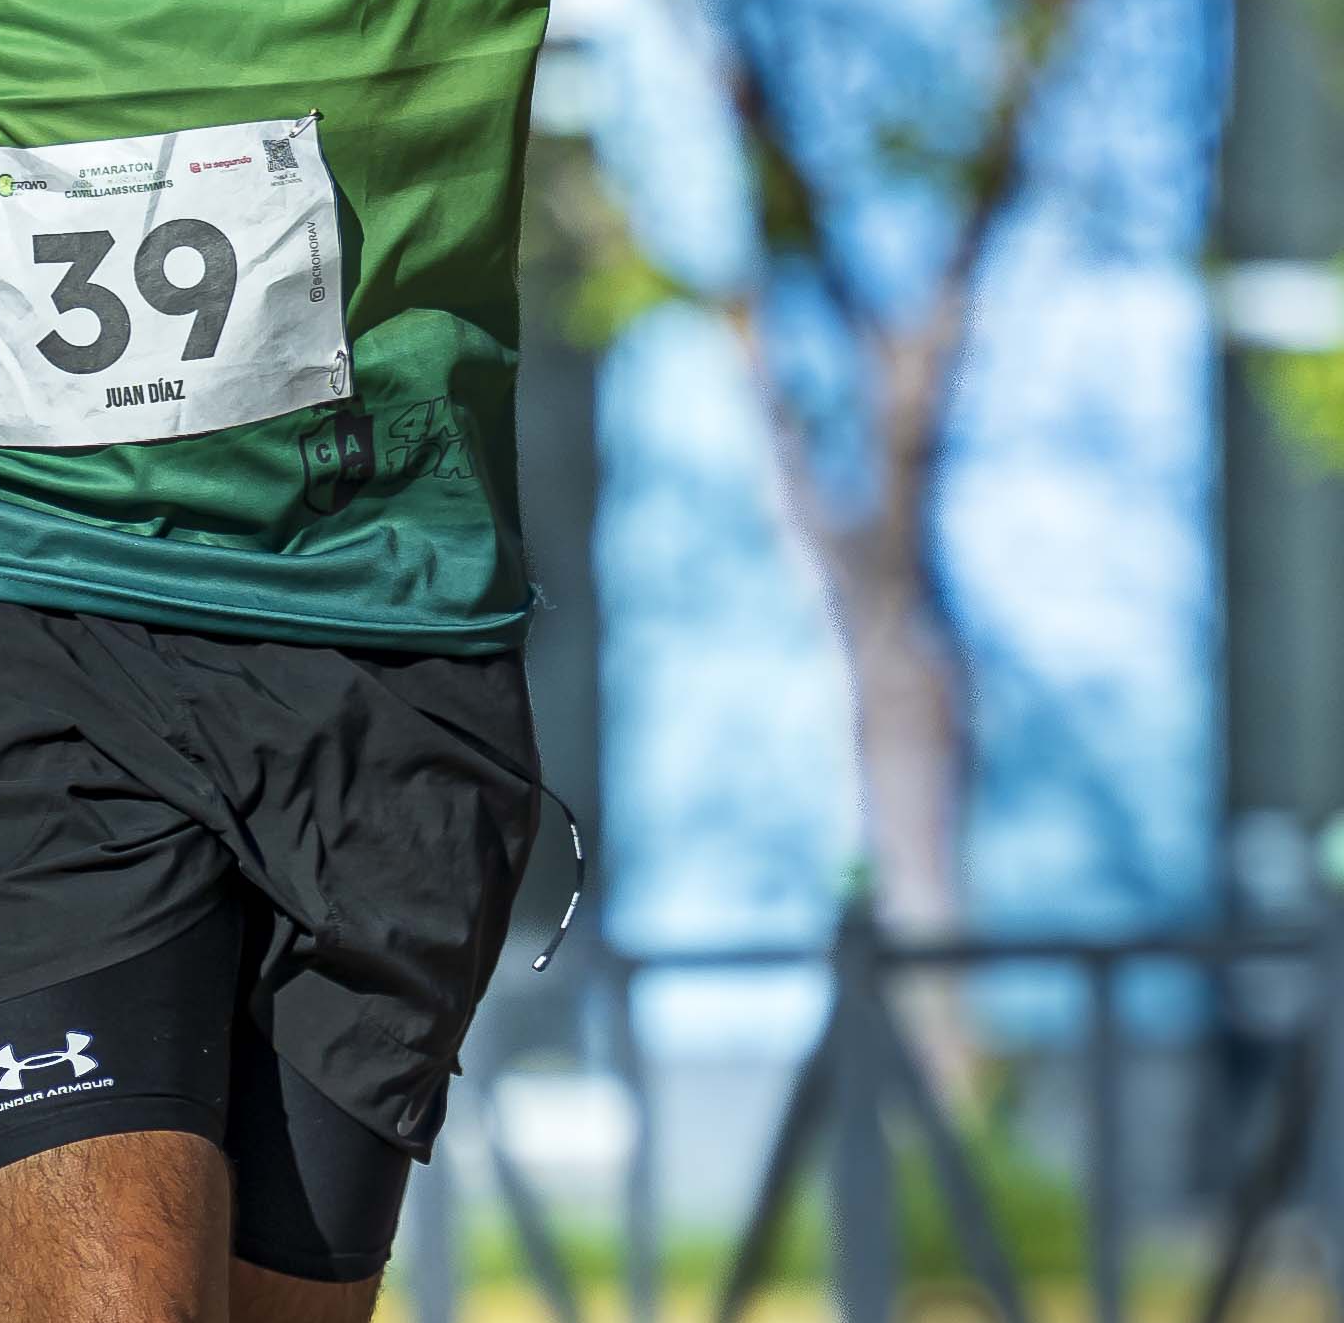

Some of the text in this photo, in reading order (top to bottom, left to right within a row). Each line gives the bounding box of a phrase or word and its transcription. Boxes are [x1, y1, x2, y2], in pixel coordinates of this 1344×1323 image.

[306, 221, 322, 285] @CRONORAV
[32, 218, 238, 375] 39
[105, 377, 186, 409] JUAN DÍAZ
[46, 1078, 115, 1098] ARMOUR
